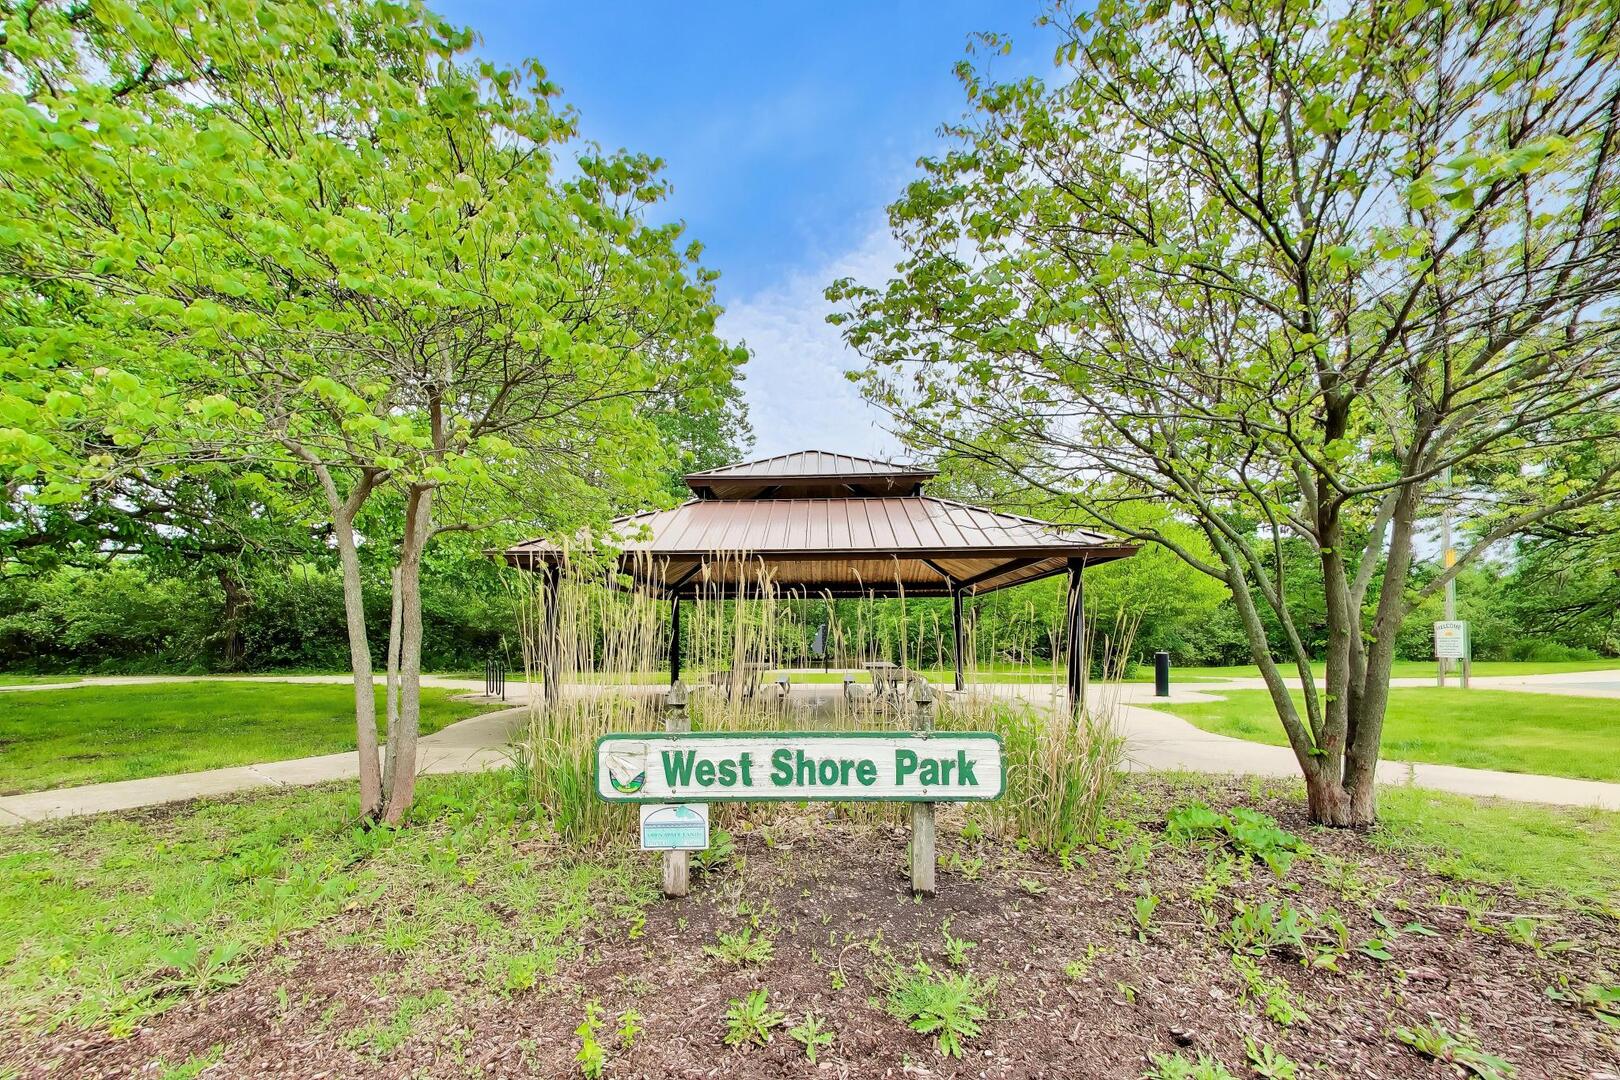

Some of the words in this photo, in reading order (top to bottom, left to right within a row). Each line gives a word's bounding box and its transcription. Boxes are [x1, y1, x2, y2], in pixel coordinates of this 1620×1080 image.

[661, 750, 754, 788] West
[770, 748, 878, 787] Shore
[895, 749, 979, 787] Park
